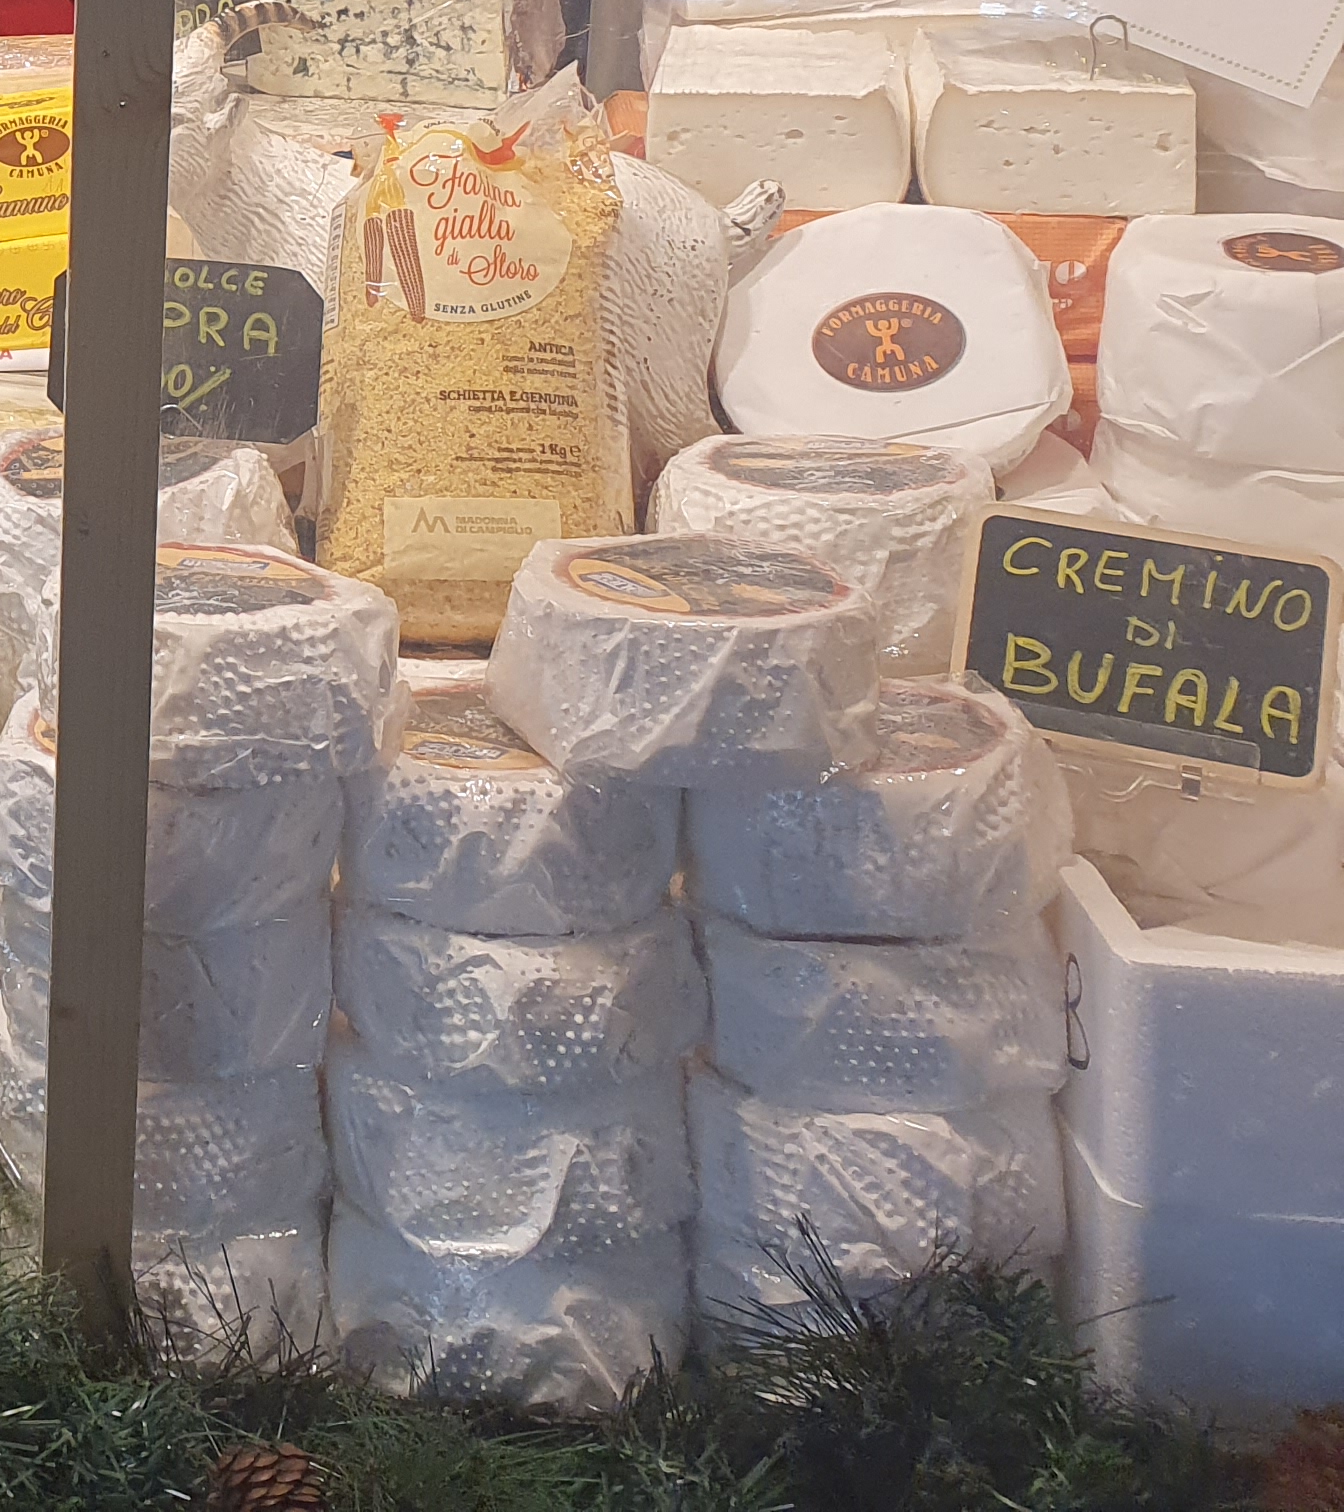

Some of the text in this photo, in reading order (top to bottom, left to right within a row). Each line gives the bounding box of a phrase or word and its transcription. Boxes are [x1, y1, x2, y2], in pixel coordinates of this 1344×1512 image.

[8, 161, 64, 179] CAMUNA
[409, 153, 522, 210] Farina
[433, 200, 516, 256] gialla
[165, 265, 269, 296] OLCE
[458, 244, 540, 286] Storo
[433, 289, 533, 315] SENZA GLUTINE
[819, 296, 945, 338] FORMAGGERIA
[528, 341, 575, 357] ANTICA
[846, 354, 940, 385] CAMUNA
[438, 389, 507, 402] SCHIETTA
[521, 391, 579, 408] GENUINA
[1126, 615, 1176, 650] DI
[1001, 632, 1302, 745] BUFALA
